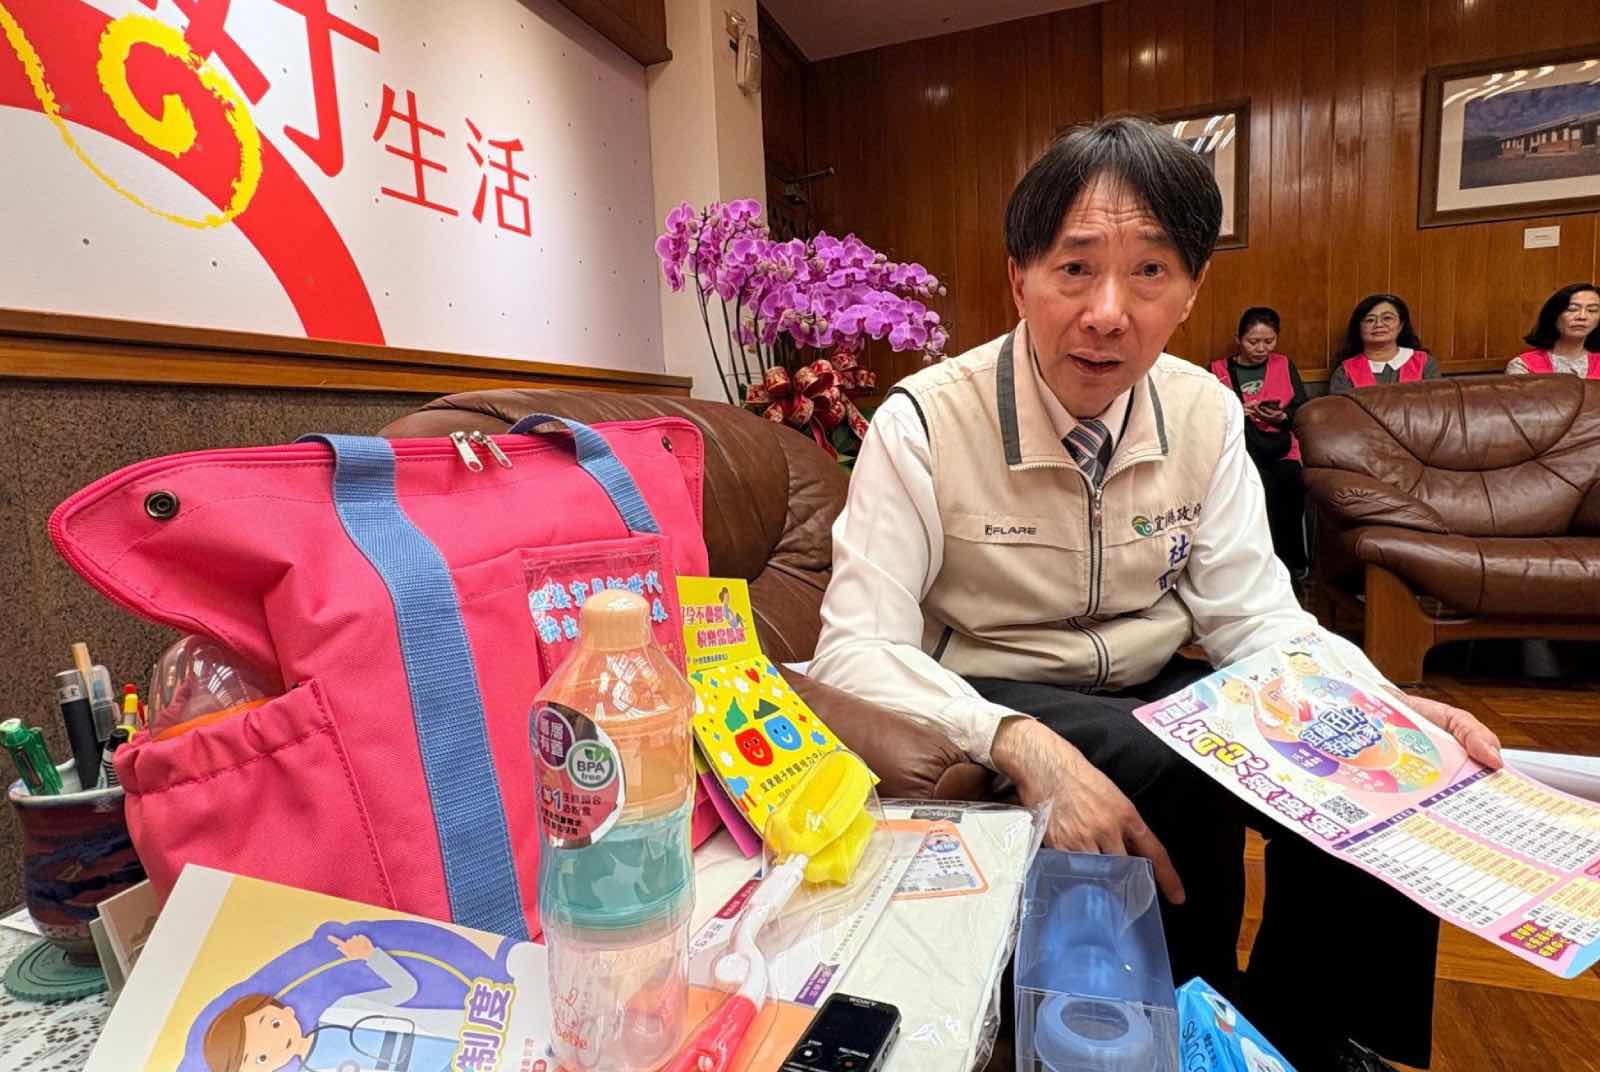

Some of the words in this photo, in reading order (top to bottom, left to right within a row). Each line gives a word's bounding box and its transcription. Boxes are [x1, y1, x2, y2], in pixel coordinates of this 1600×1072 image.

[372, 84, 532, 237] 生活
[576, 761, 605, 774] BPA
[581, 772, 602, 781] free
[456, 983, 511, 1072] 制度
